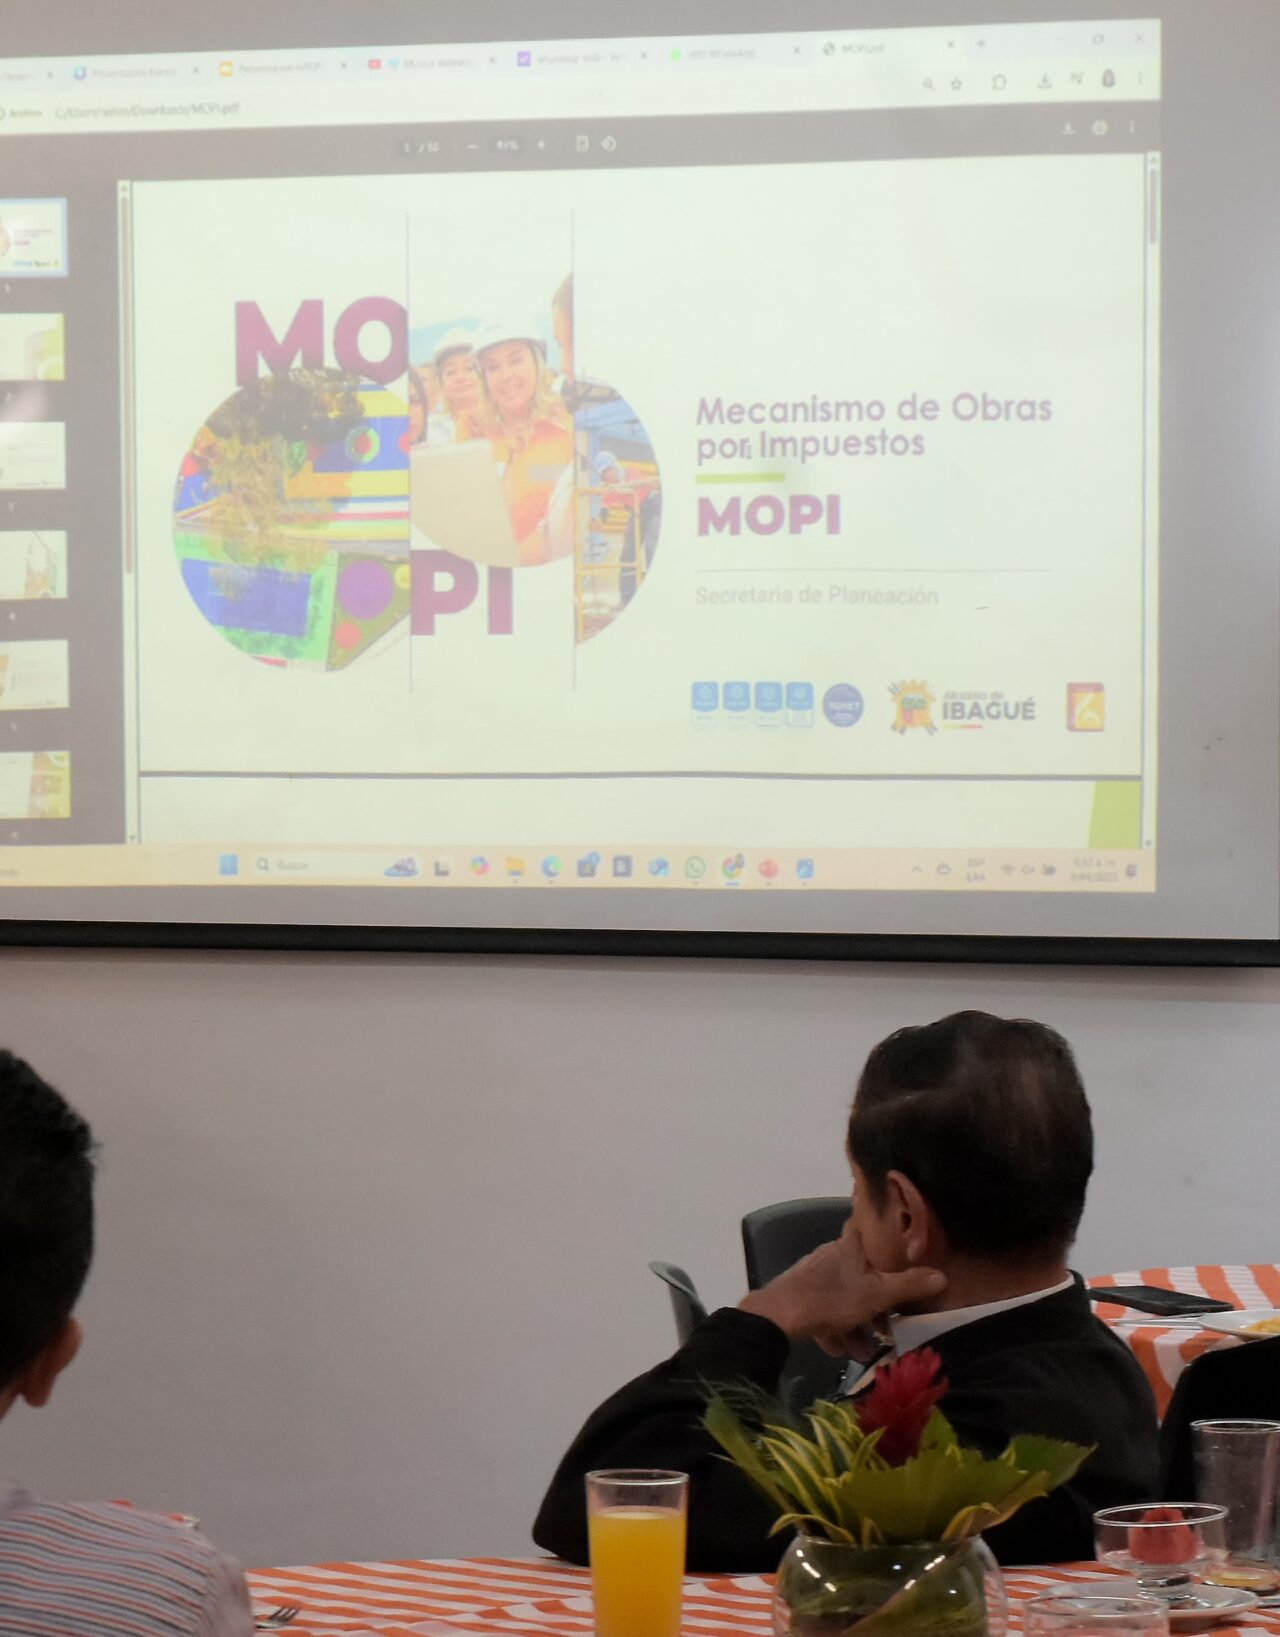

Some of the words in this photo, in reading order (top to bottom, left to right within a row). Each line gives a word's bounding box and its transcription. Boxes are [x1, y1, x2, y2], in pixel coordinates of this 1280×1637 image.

[234, 296, 411, 388] MO
[696, 394, 886, 426] Mecanismo
[897, 393, 940, 422] de
[952, 391, 1053, 423] Obras
[697, 436, 749, 466] por
[760, 428, 925, 464] Impuestos
[697, 494, 841, 537] MOPI
[798, 583, 823, 604] de
[828, 583, 940, 606] Planeación
[942, 696, 1037, 721] IBAGUÉ
